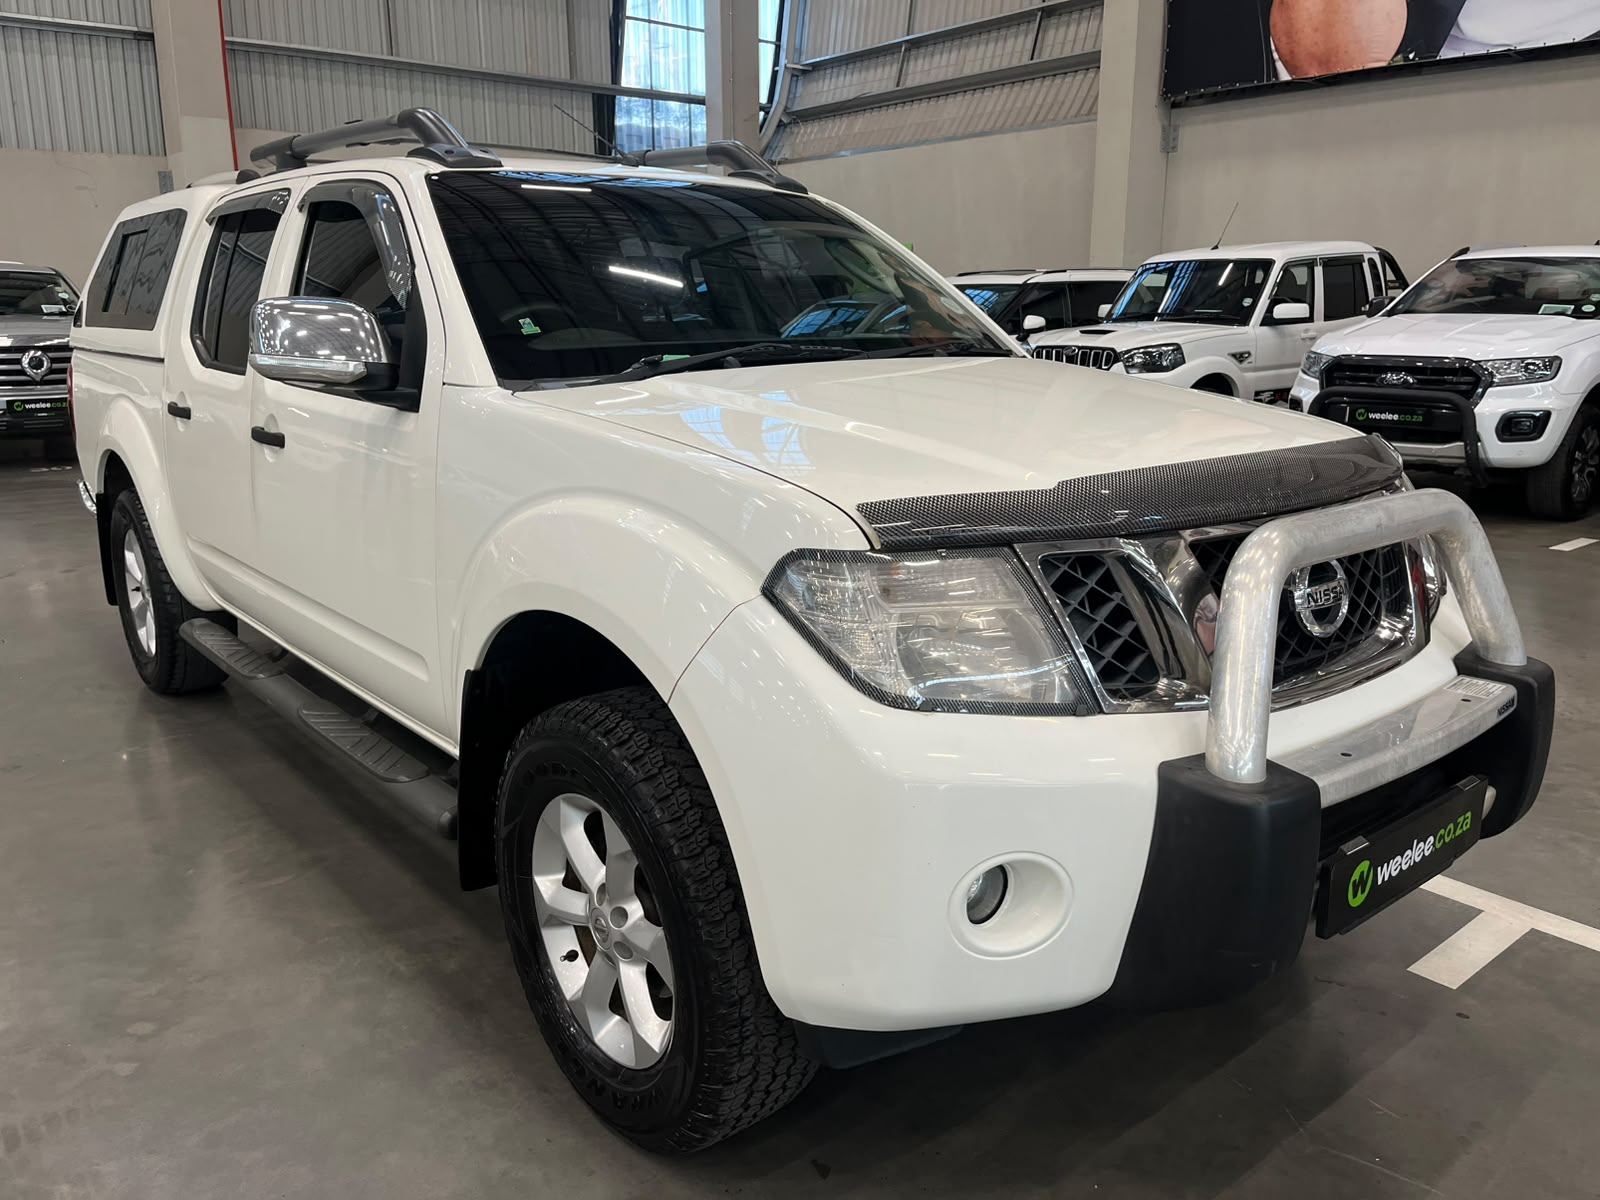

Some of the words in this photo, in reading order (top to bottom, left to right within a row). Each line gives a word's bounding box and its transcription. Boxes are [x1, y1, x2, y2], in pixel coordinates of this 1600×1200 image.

[1369, 411, 1423, 421] weelee.co.za
[1307, 584, 1345, 606] NISSA
[1377, 811, 1472, 885] weelee.co.za
